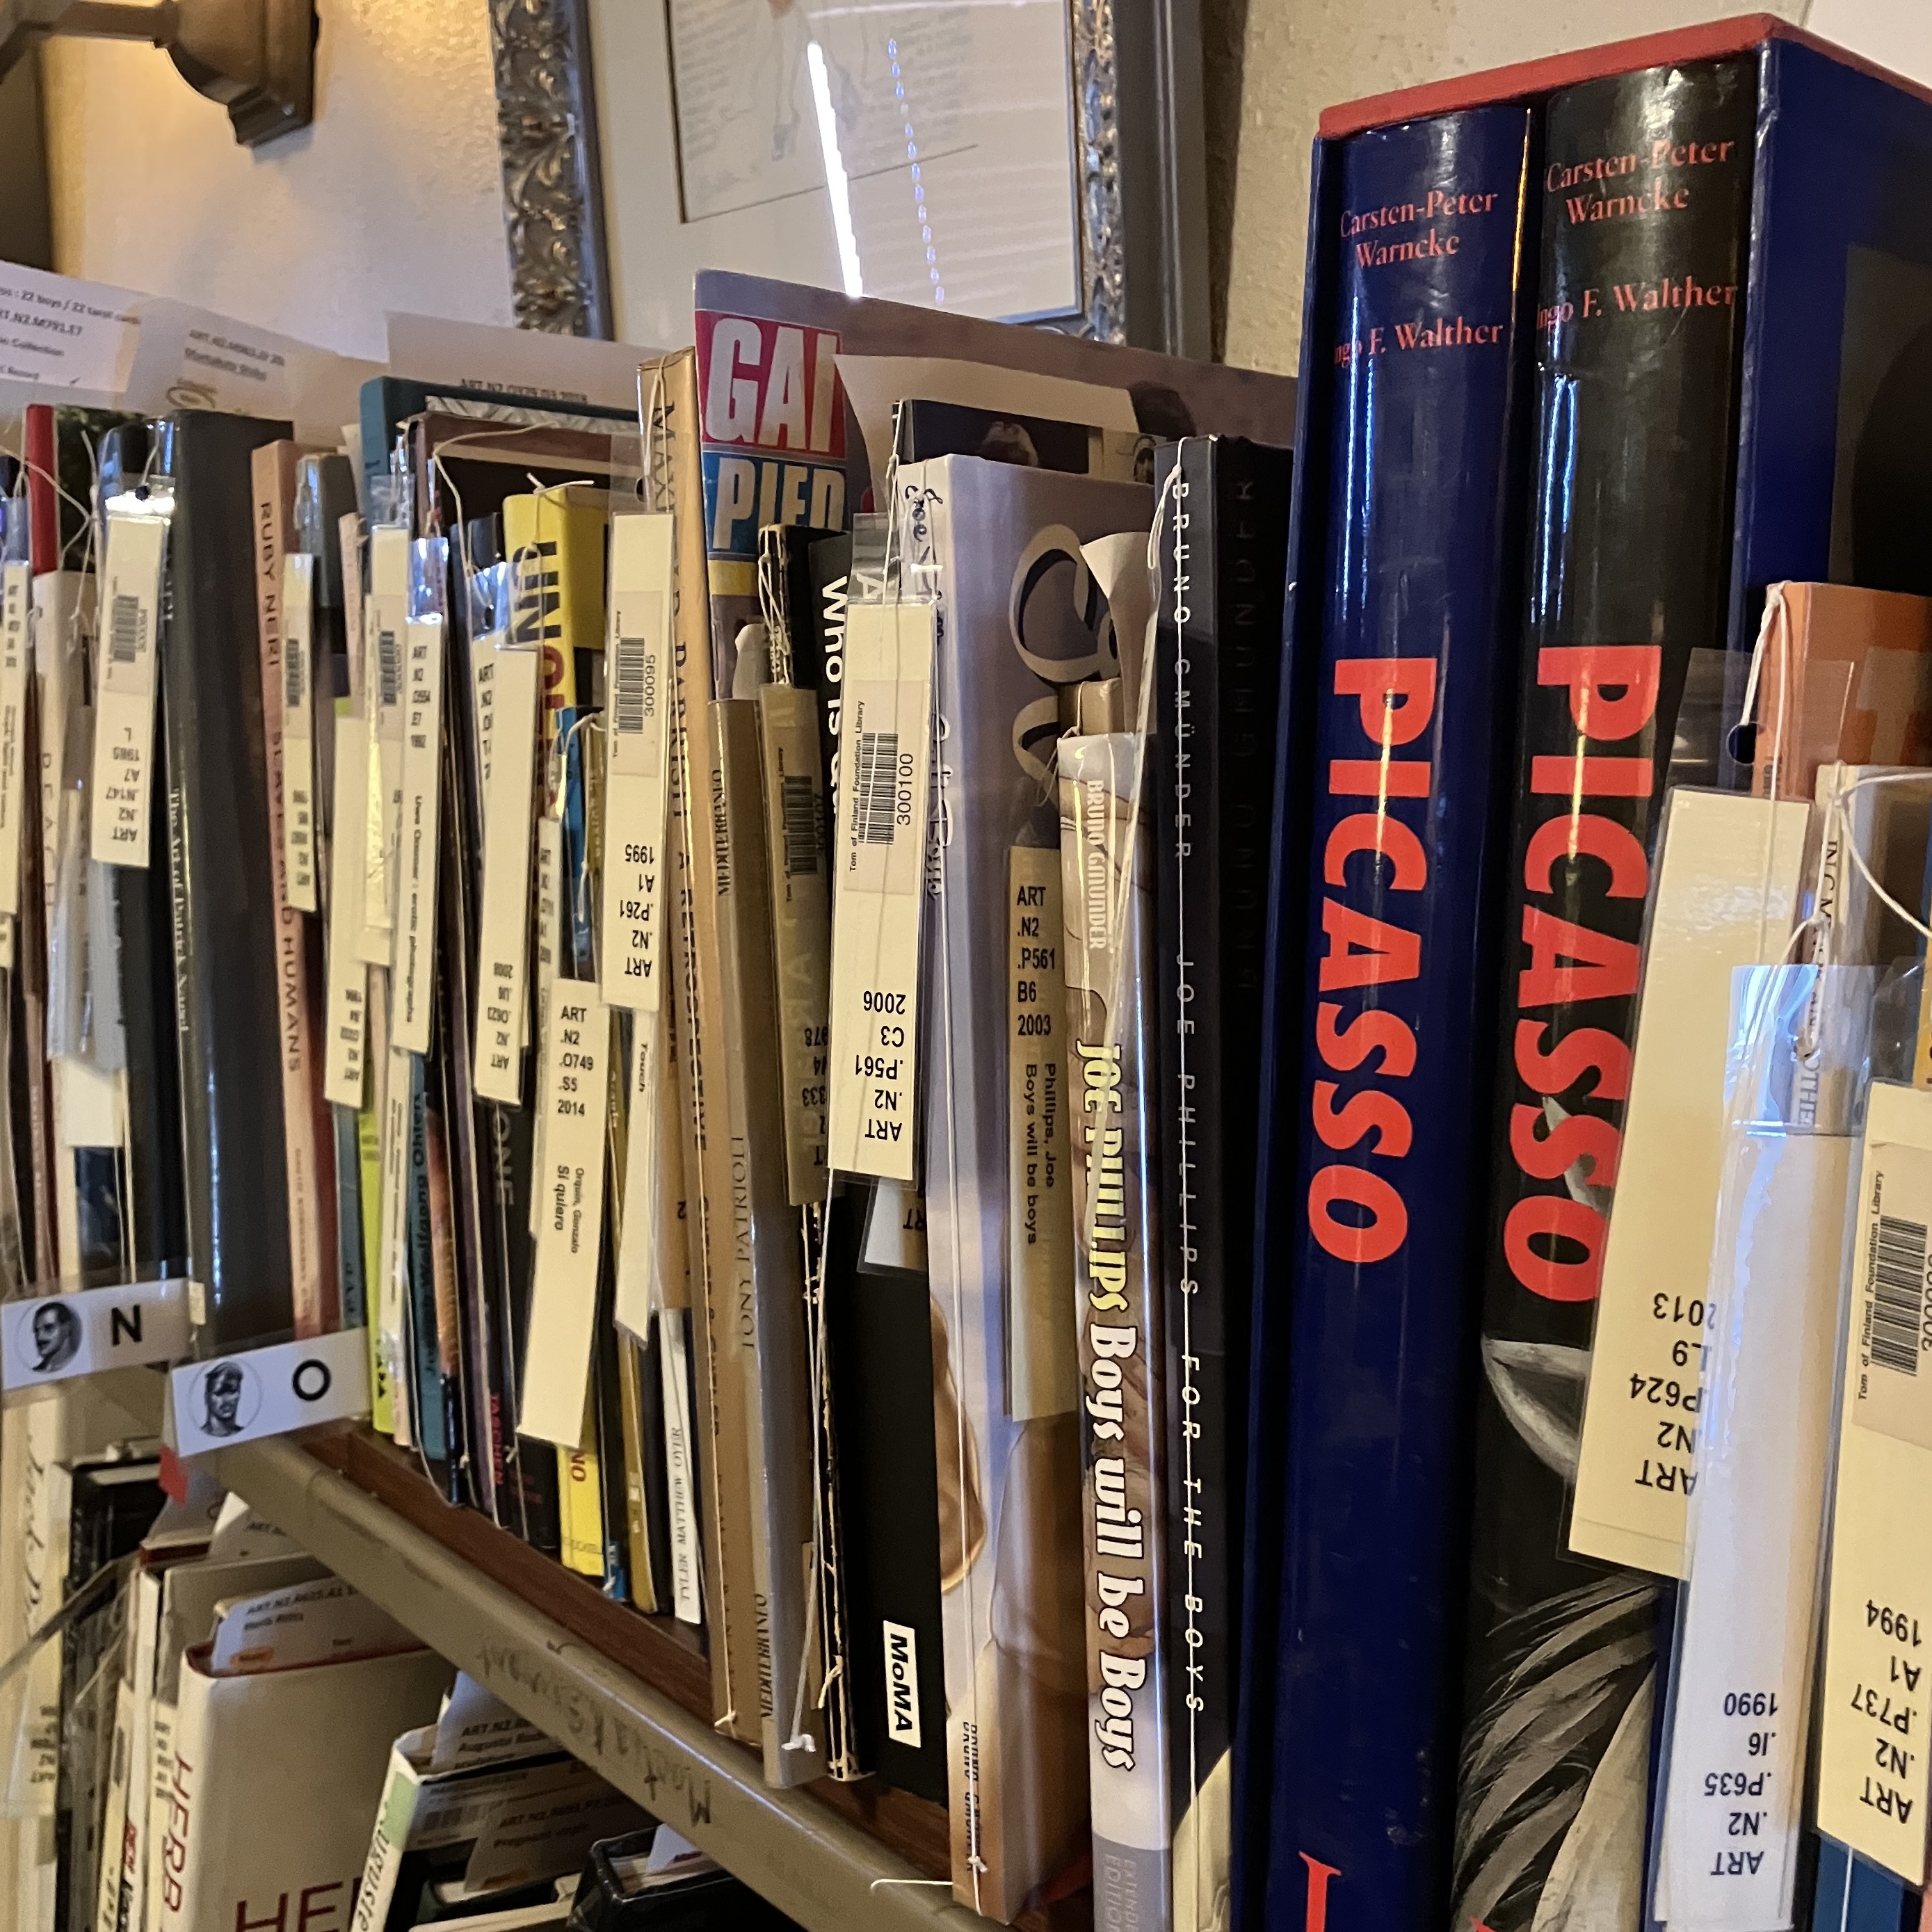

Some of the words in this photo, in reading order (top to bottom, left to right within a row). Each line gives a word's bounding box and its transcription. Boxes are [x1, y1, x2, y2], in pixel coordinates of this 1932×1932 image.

[1546, 139, 1735, 193] Carsten-Peter
[1340, 191, 1498, 237] Carsten-Peter
[1566, 177, 1690, 224] Warncke
[1355, 230, 1460, 268] Warncke
[1582, 289, 1602, 319] F.
[1613, 275, 1737, 312] Walther
[1333, 339, 1362, 366] ngo
[1369, 328, 1387, 355] F.
[1396, 316, 1504, 349] Walther
[704, 318, 839, 453] GAI
[1173, 482, 1190, 623] BRUNO
[644, 654, 656, 717] 300095
[856, 700, 865, 734] Library
[853, 736, 862, 792] Foundation
[1174, 659, 1192, 858] GMÜNDER
[260, 502, 275, 576] RUBY
[284, 937, 301, 1072] HUMANS
[898, 752, 914, 826] 300100
[851, 794, 860, 832] Finland
[1086, 780, 1106, 846] BRUNO
[112, 828, 138, 842] ART
[625, 844, 654, 864] 1995
[851, 835, 859, 844] of
[638, 873, 654, 892] A1
[1017, 886, 1046, 906] ART
[620, 899, 654, 922] .P261
[1017, 917, 1040, 937] .N2
[631, 930, 652, 950] .N2
[1017, 948, 1056, 970] .P561
[625, 958, 652, 978] ART
[1308, 659, 1438, 1263] PICASSO
[1504, 645, 1662, 1301] PICASSO
[862, 991, 906, 1015] 2006
[1017, 981, 1037, 1002] B6
[1175, 952, 1195, 1036] JOE
[561, 1006, 587, 1022] ART
[1017, 1015, 1052, 1036] 2003
[560, 1029, 580, 1045] .N2
[880, 1026, 905, 1047] C3
[558, 1077, 577, 1092] .S5
[638, 1042, 650, 1093] Touch
[855, 1054, 904, 1079] .P561
[557, 1099, 585, 1116] 2014
[874, 1090, 903, 1111] .N2
[1025, 1064, 1038, 1116] Boys
[1044, 1063, 1058, 1144] Phillips,
[865, 1120, 903, 1142] ART
[1027, 1120, 1038, 1155] will
[1027, 1162, 1038, 1182] be
[1046, 1150, 1058, 1189] Joe
[1178, 1074, 1198, 1295] PHILLIPS
[1871, 1170, 1885, 1215] Library
[903, 1208, 926, 1229] RT
[1025, 1198, 1040, 1245] boys
[1865, 1223, 1879, 1294] Foundation
[111, 1305, 143, 1346] N
[1653, 1292, 1717, 1330] 2013
[1862, 1301, 1874, 1347] Finland
[292, 1358, 331, 1402] O
[1862, 1353, 1870, 1367] of
[1086, 1323, 1138, 1442] Boys
[1181, 1355, 1200, 1439] FOR
[1858, 1374, 1869, 1401] Tom
[1635, 1459, 1698, 1496] ART
[1094, 1458, 1145, 1561] will
[1184, 1479, 1202, 1559] THE
[1096, 1571, 1145, 1639] be
[1867, 1600, 1923, 1648] 1994
[1184, 1596, 1204, 1712] BOYS
[1890, 1656, 1922, 1692] A1
[889, 1632, 913, 1732] MoMA
[1095, 1652, 1148, 1773] Boys
[1724, 1692, 1779, 1718] 1990
[1851, 1684, 1917, 1734] .P737
[1876, 1738, 1915, 1780] .N2
[1705, 1772, 1773, 1797] .P635
[1860, 1776, 1913, 1826] ART
[162, 1753, 193, 1914] HERB
[1728, 1811, 1769, 1837] .N2
[1710, 1851, 1764, 1877] ART
